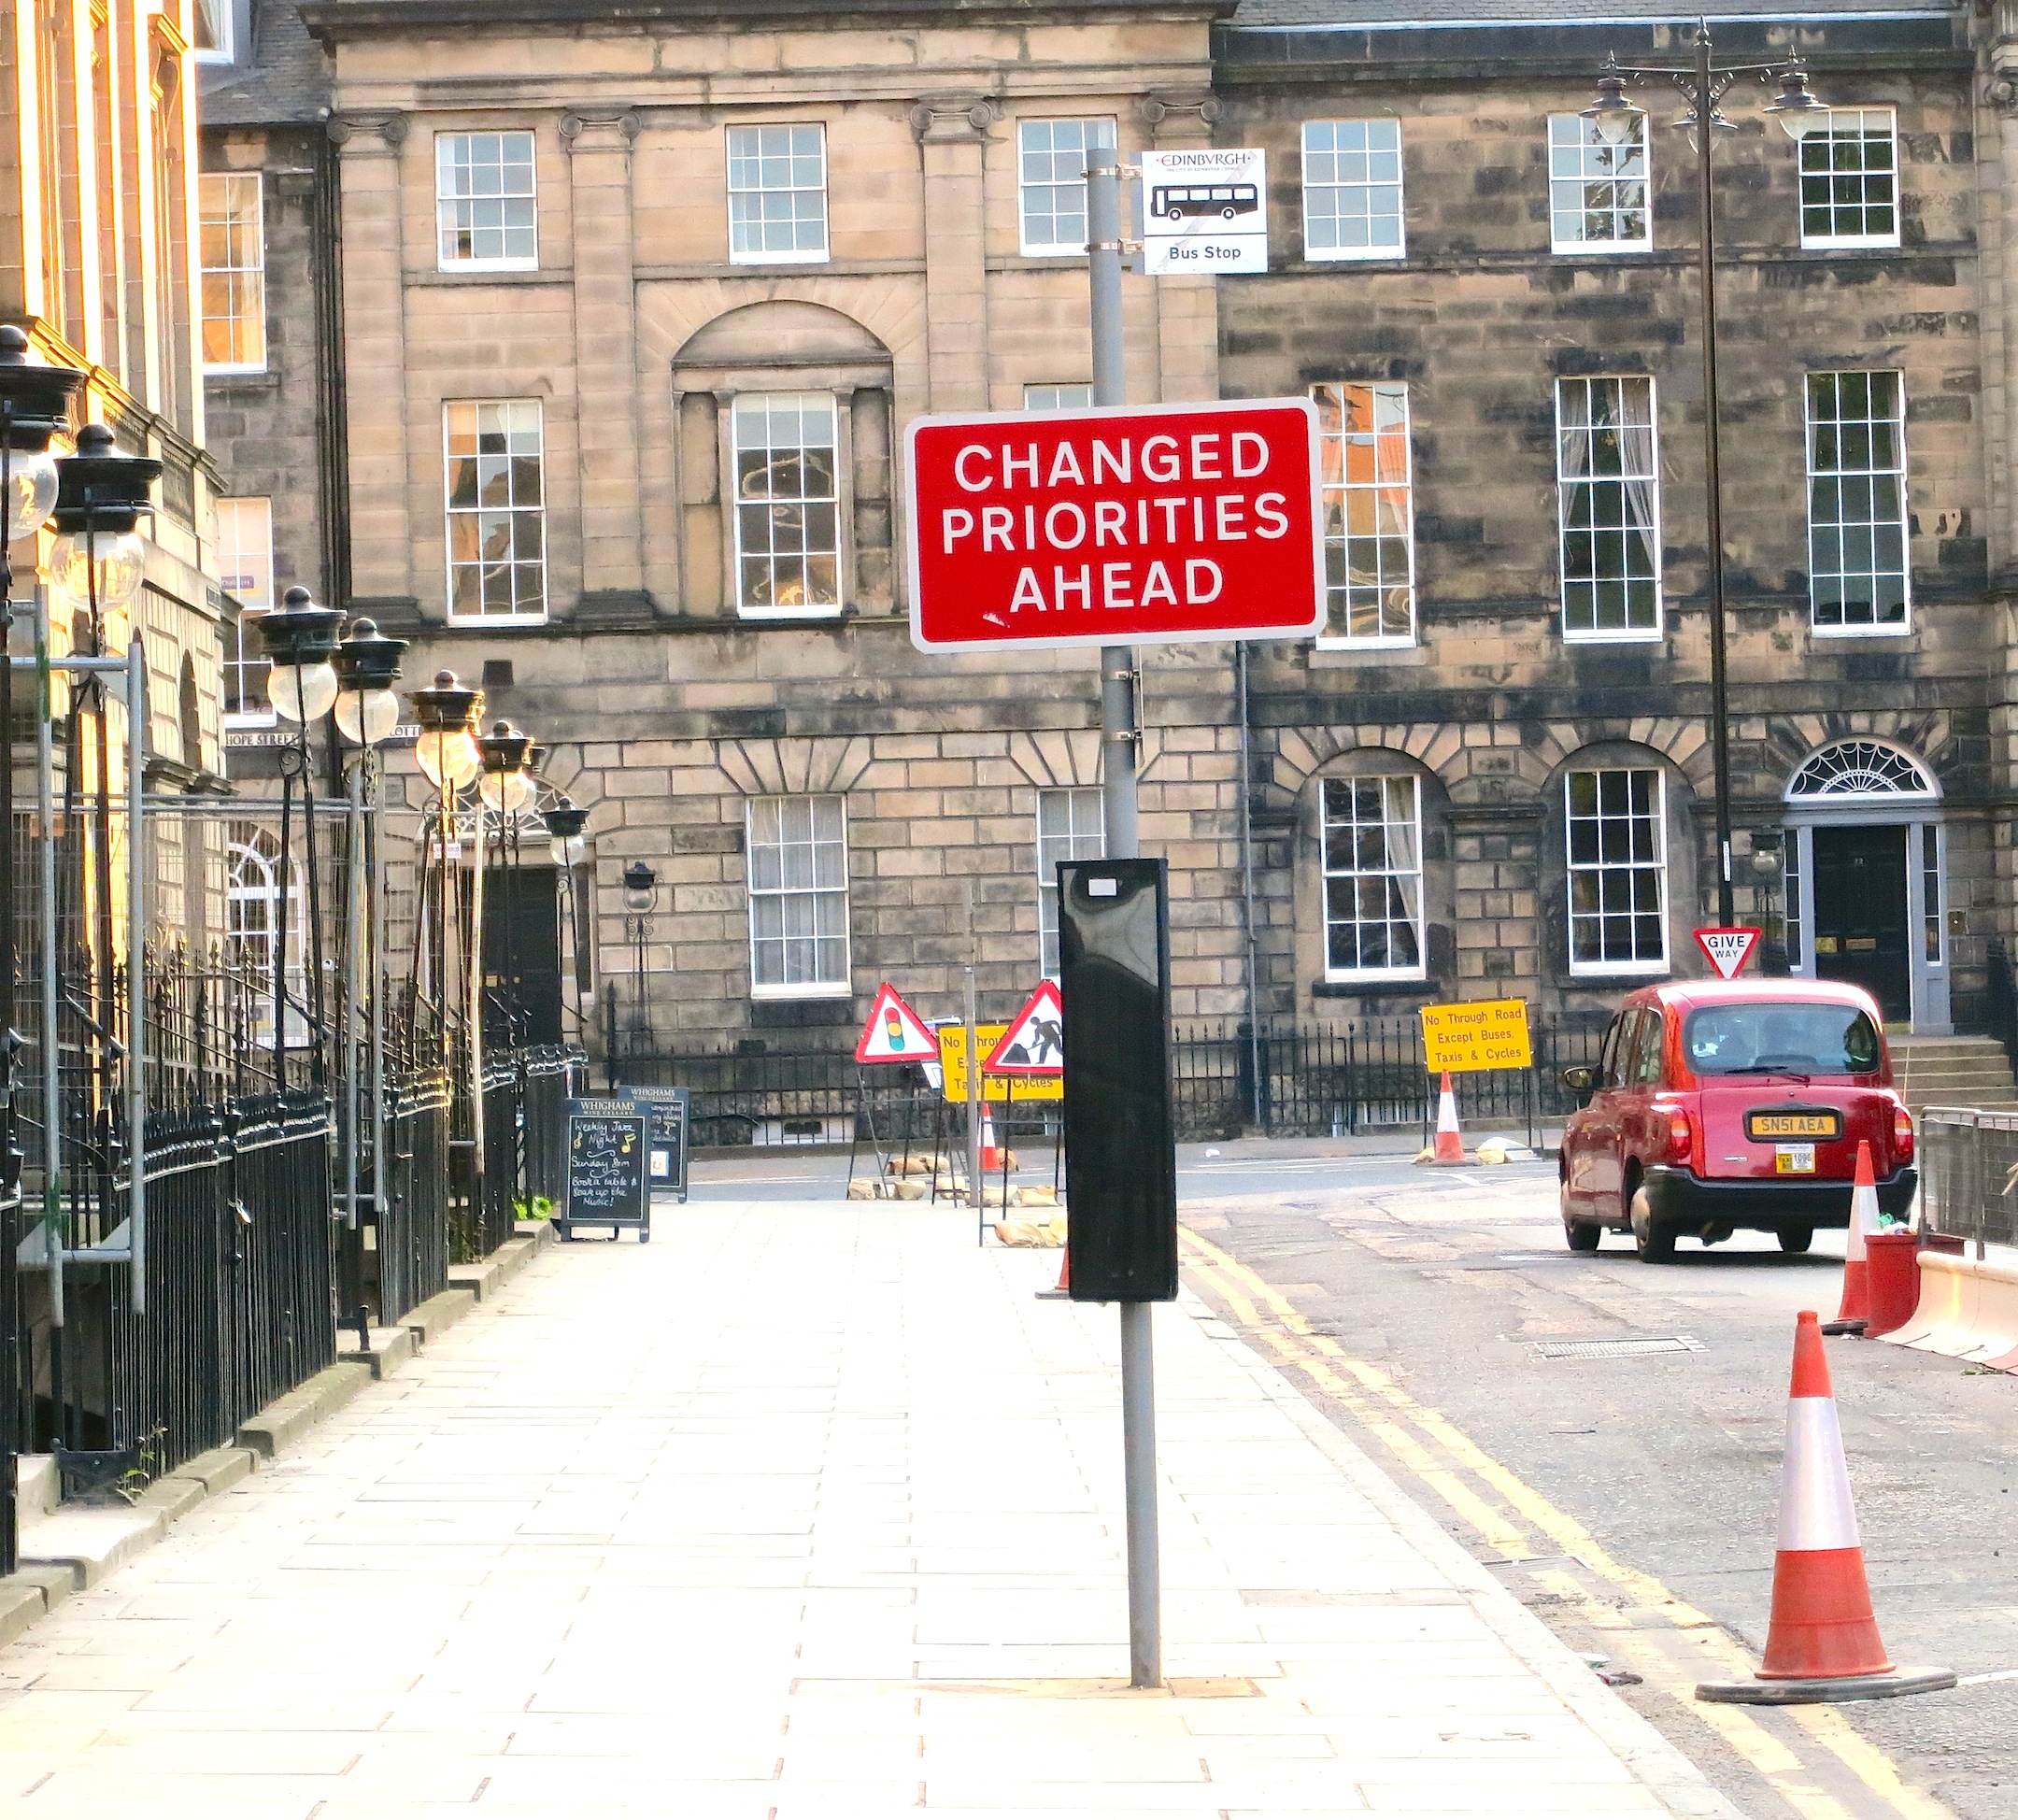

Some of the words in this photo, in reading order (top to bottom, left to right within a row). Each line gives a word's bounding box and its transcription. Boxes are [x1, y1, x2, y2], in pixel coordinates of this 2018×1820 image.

[1161, 153, 1245, 166] EDINBVRGH
[1170, 247, 1199, 260] Bus
[1204, 246, 1242, 260] Stop
[954, 432, 1270, 493] CHANGED
[943, 491, 1289, 554] PRIORITIES
[1009, 558, 1224, 613] AHEAD
[226, 734, 253, 746] HOPE
[1708, 935, 1745, 948] GIVE
[1715, 949, 1739, 959] WAY
[1426, 1016, 1440, 1026] No
[1447, 1012, 1488, 1025] Through
[1495, 1008, 1522, 1020] Road
[944, 1035, 959, 1048] No
[1438, 1031, 1473, 1045] Except
[1435, 1051, 1463, 1063] Taxis
[1471, 1050, 1479, 1060] &
[1485, 1047, 1522, 1061] Cycles
[1013, 1078, 1054, 1090] Cycles
[631, 1088, 675, 1097] WHIGHAMS
[580, 1102, 635, 1111] WHIGHAMS
[611, 1120, 635, 1132] Jazz
[1761, 1117, 1793, 1131] SN51
[1798, 1117, 1826, 1131] AEA
[589, 1133, 618, 1149] Night
[571, 1155, 608, 1174] Sunday
[611, 1187, 628, 1197] the
